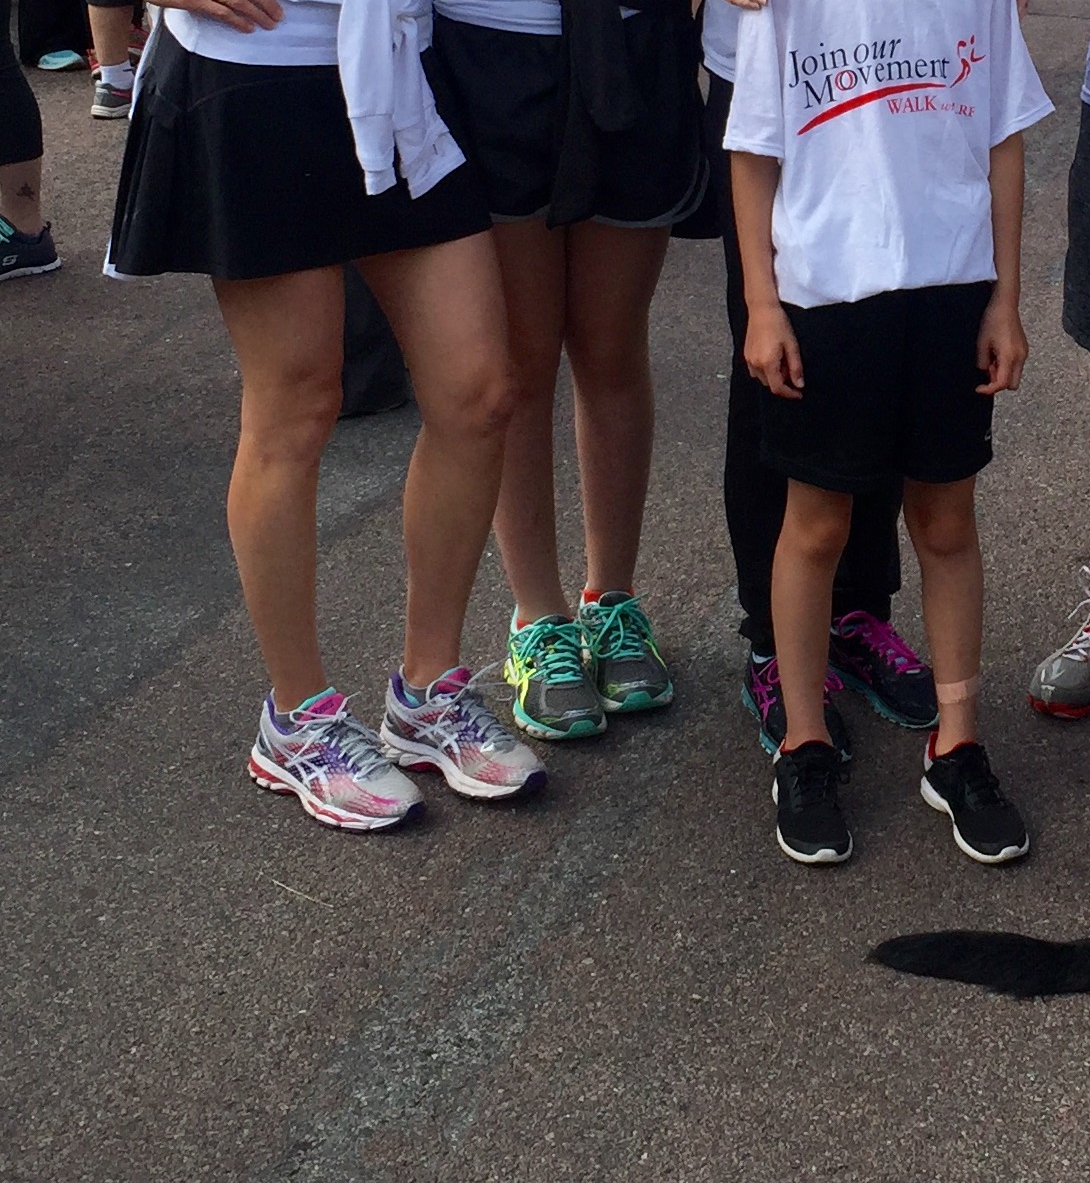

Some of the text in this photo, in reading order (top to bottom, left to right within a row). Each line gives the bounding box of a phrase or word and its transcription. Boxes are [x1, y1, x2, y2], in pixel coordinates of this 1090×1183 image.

[789, 38, 902, 88] Join our
[804, 57, 950, 109] Movement
[887, 95, 938, 115] WALK
[955, 104, 976, 118] RF
